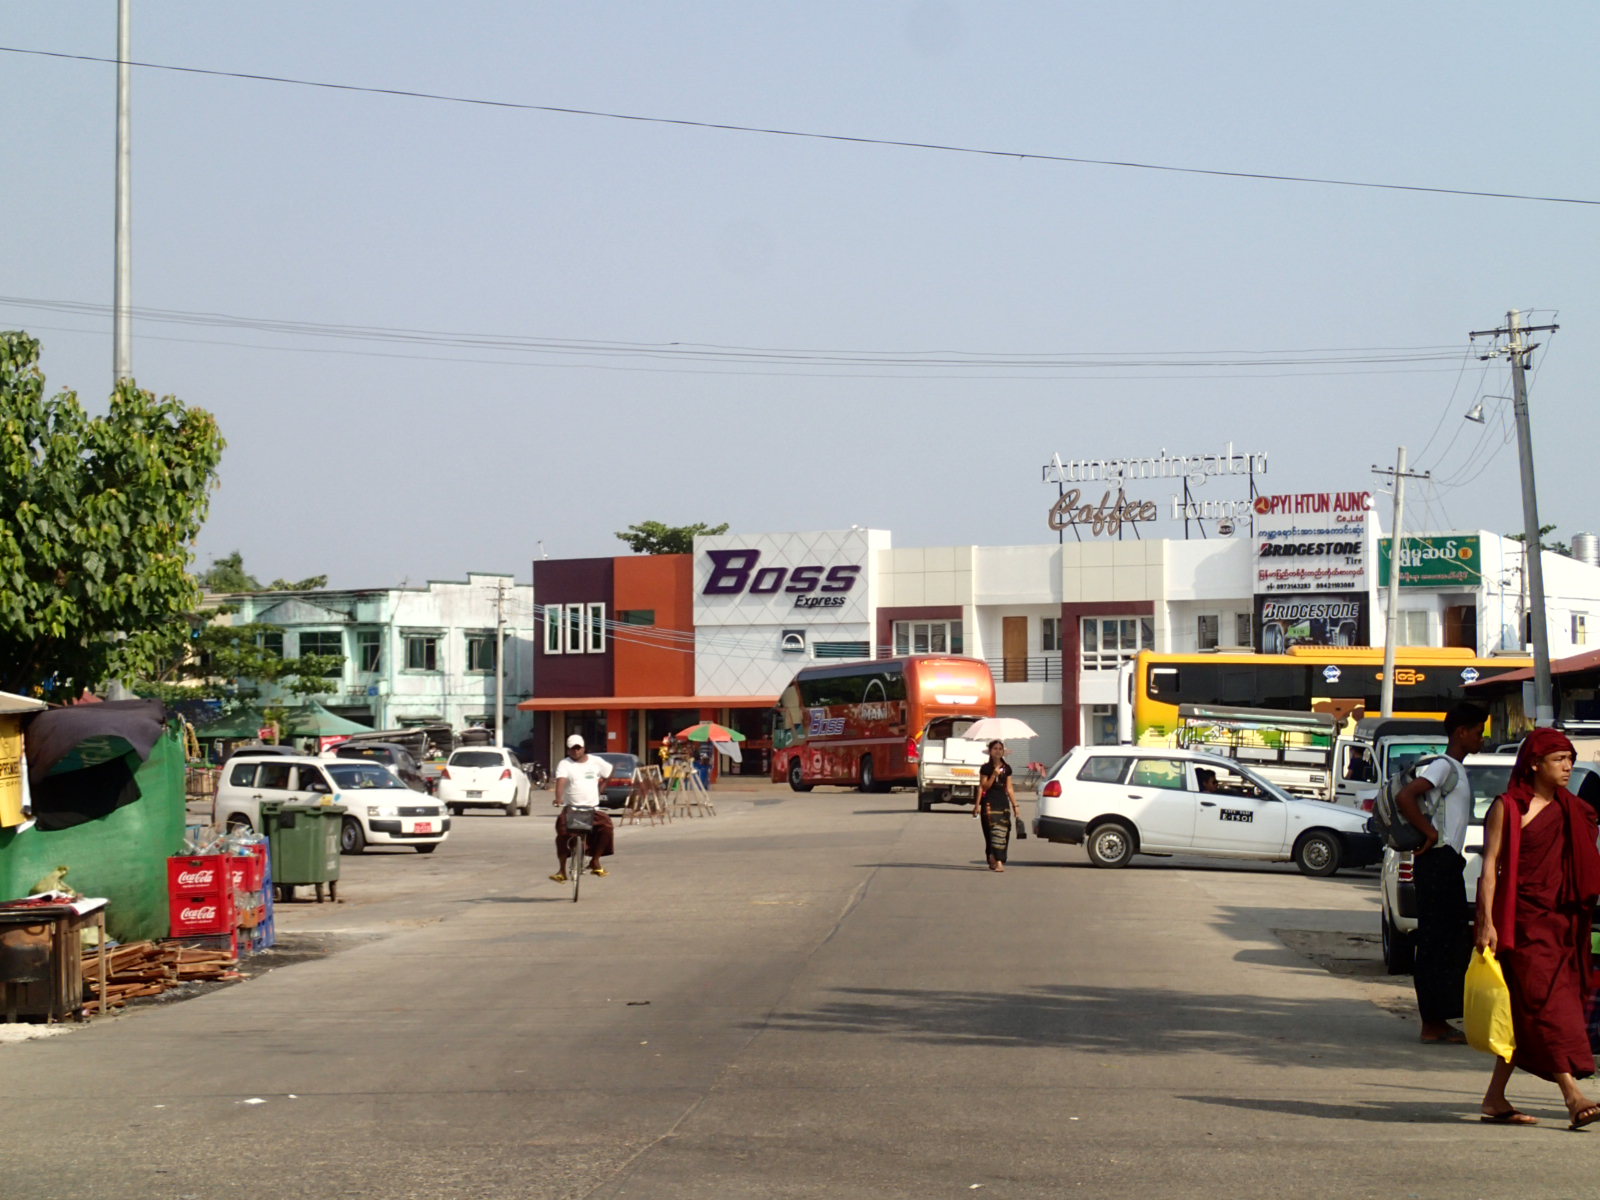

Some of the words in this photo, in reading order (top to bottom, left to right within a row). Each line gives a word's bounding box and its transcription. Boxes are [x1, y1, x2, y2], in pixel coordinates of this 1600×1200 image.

[1271, 495, 1292, 514] PYI
[1295, 493, 1329, 513] HTUN
[1048, 489, 1155, 537] Coffee
[1170, 493, 1254, 527] Loung
[1260, 541, 1362, 557] BRIDGESTONE
[1345, 557, 1362, 565] Tire
[794, 594, 846, 608] Express
[1263, 602, 1360, 619] BRIDGESTONE
[177, 870, 214, 884] Coca-Cola
[181, 906, 217, 920] Coca-Cola
